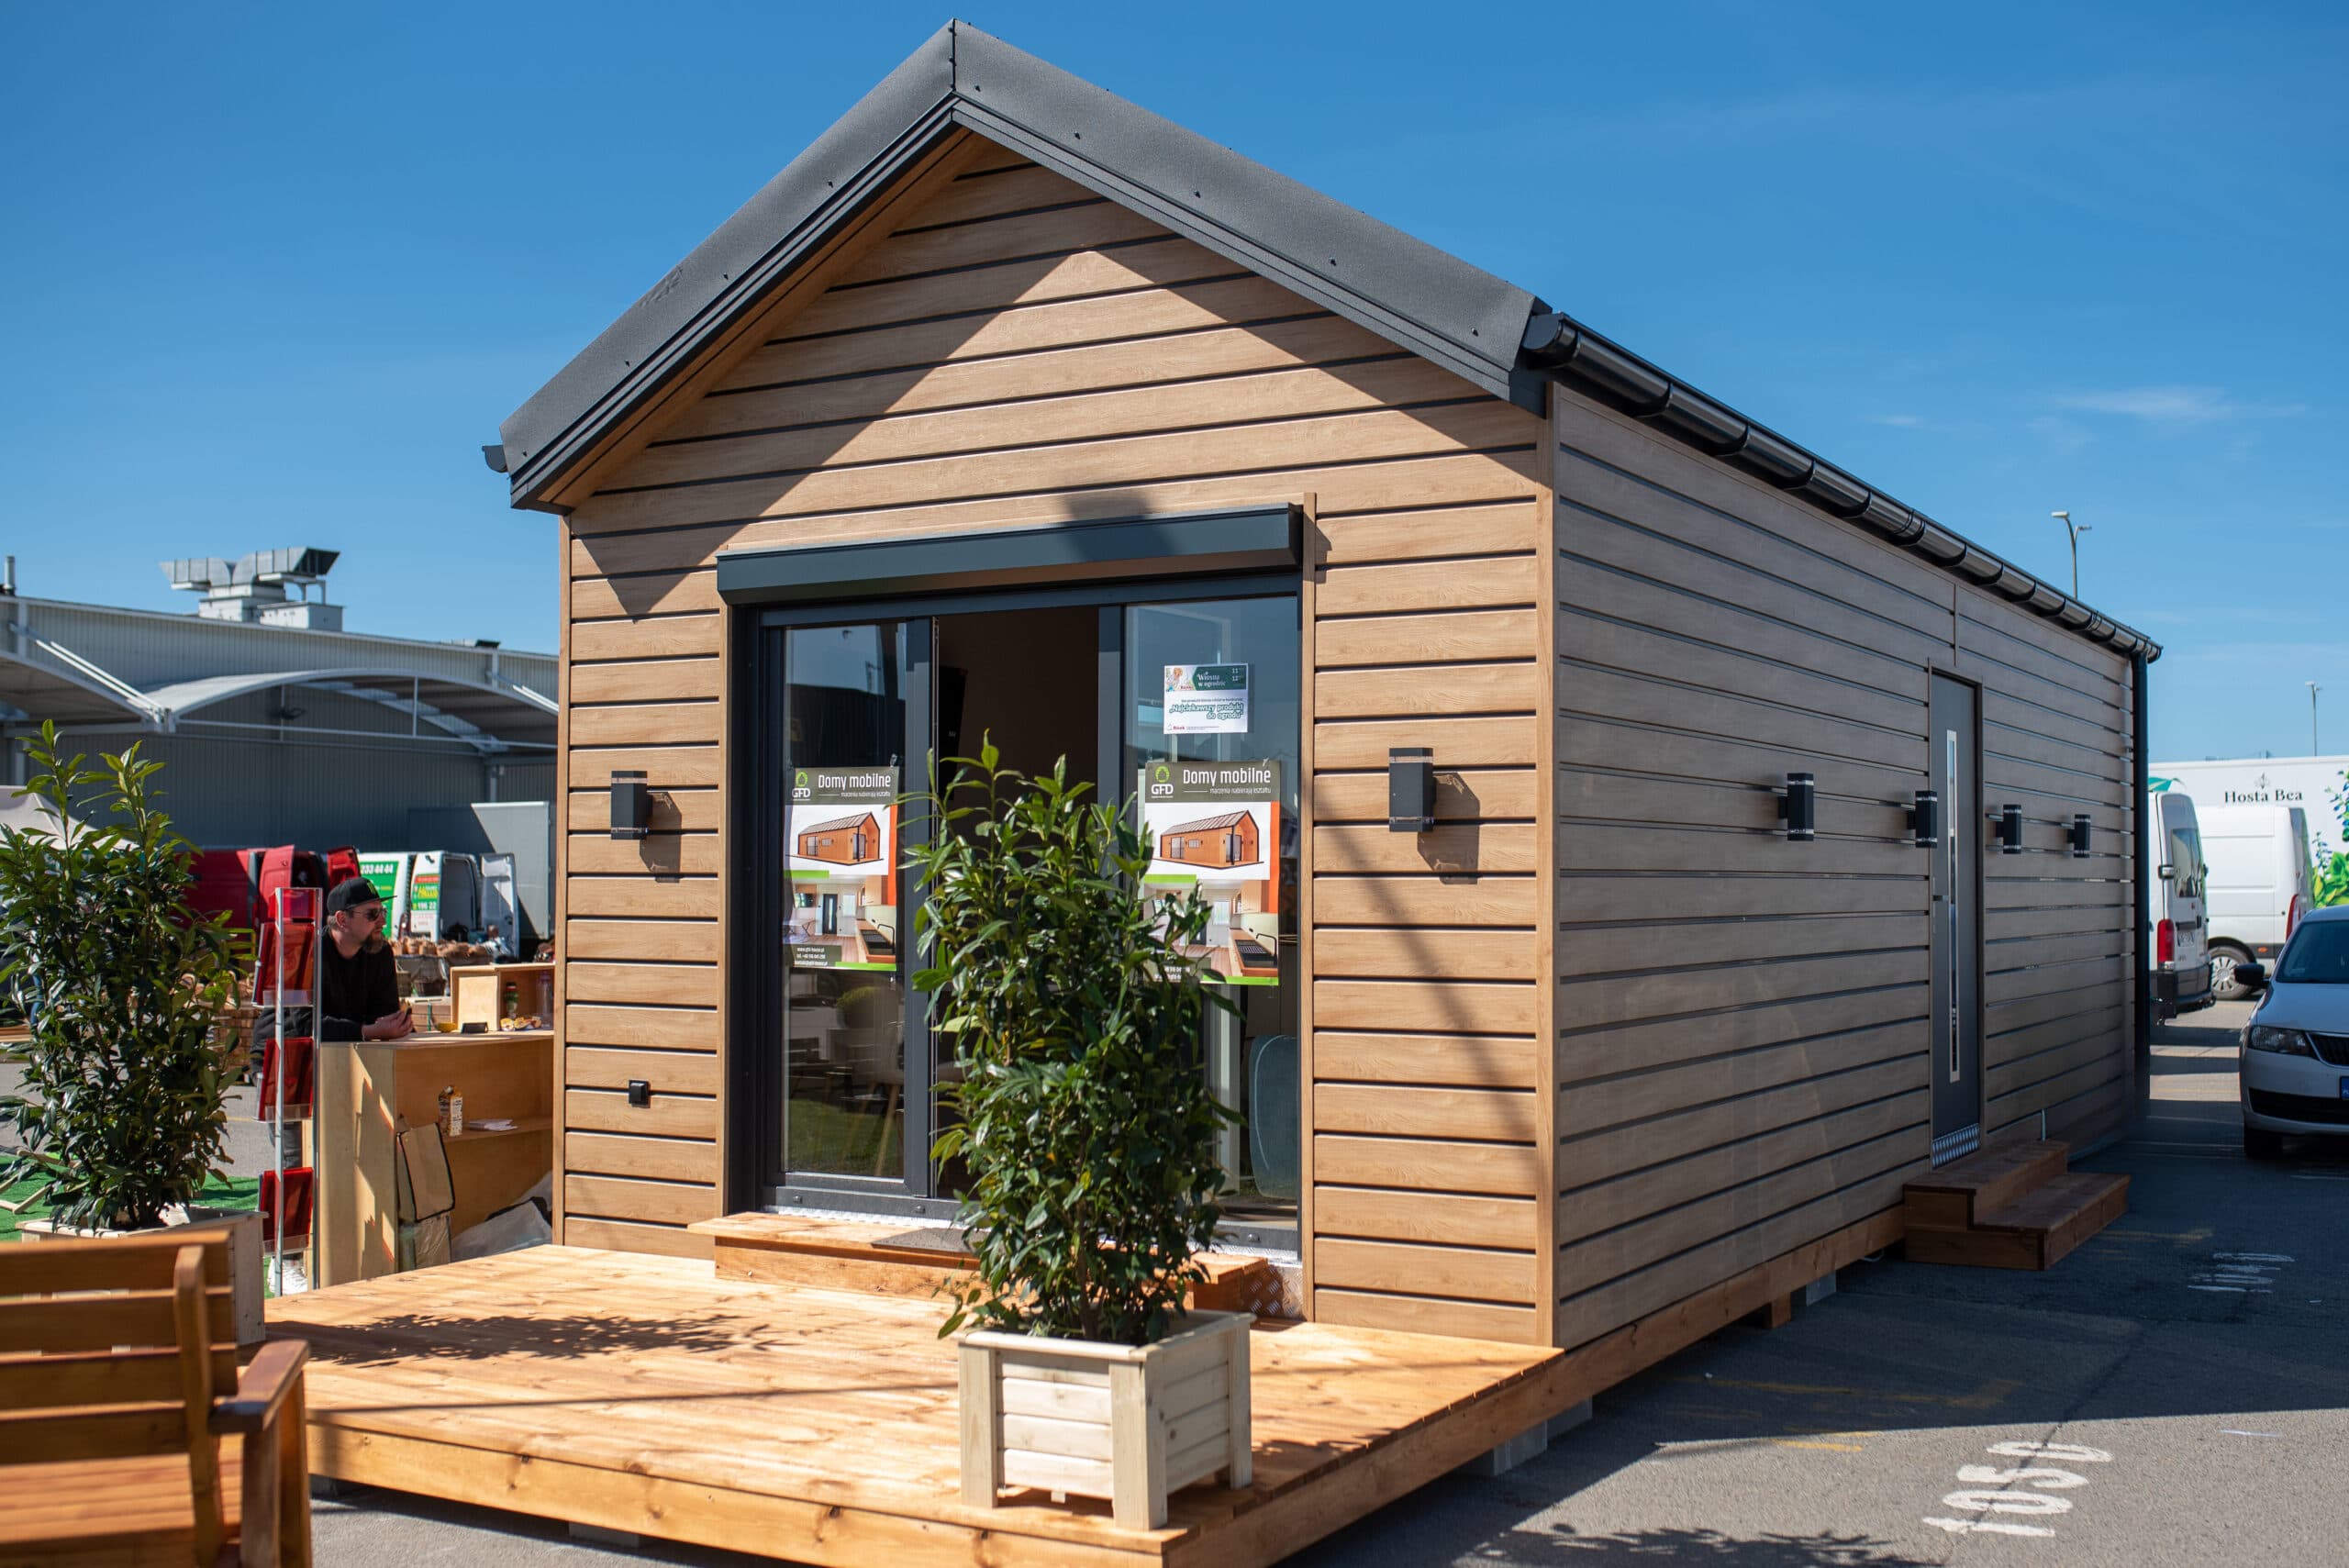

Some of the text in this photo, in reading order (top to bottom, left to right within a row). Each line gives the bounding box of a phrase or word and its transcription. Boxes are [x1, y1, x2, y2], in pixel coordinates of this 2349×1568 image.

[818, 773, 892, 791] Domy mobilne
[1183, 767, 1272, 786] Domy mobilne
[791, 787, 811, 798] GFD
[1151, 784, 1174, 795] GFD
[2224, 790, 2269, 804] Hosta
[1922, 1441, 2113, 1537] 1050
